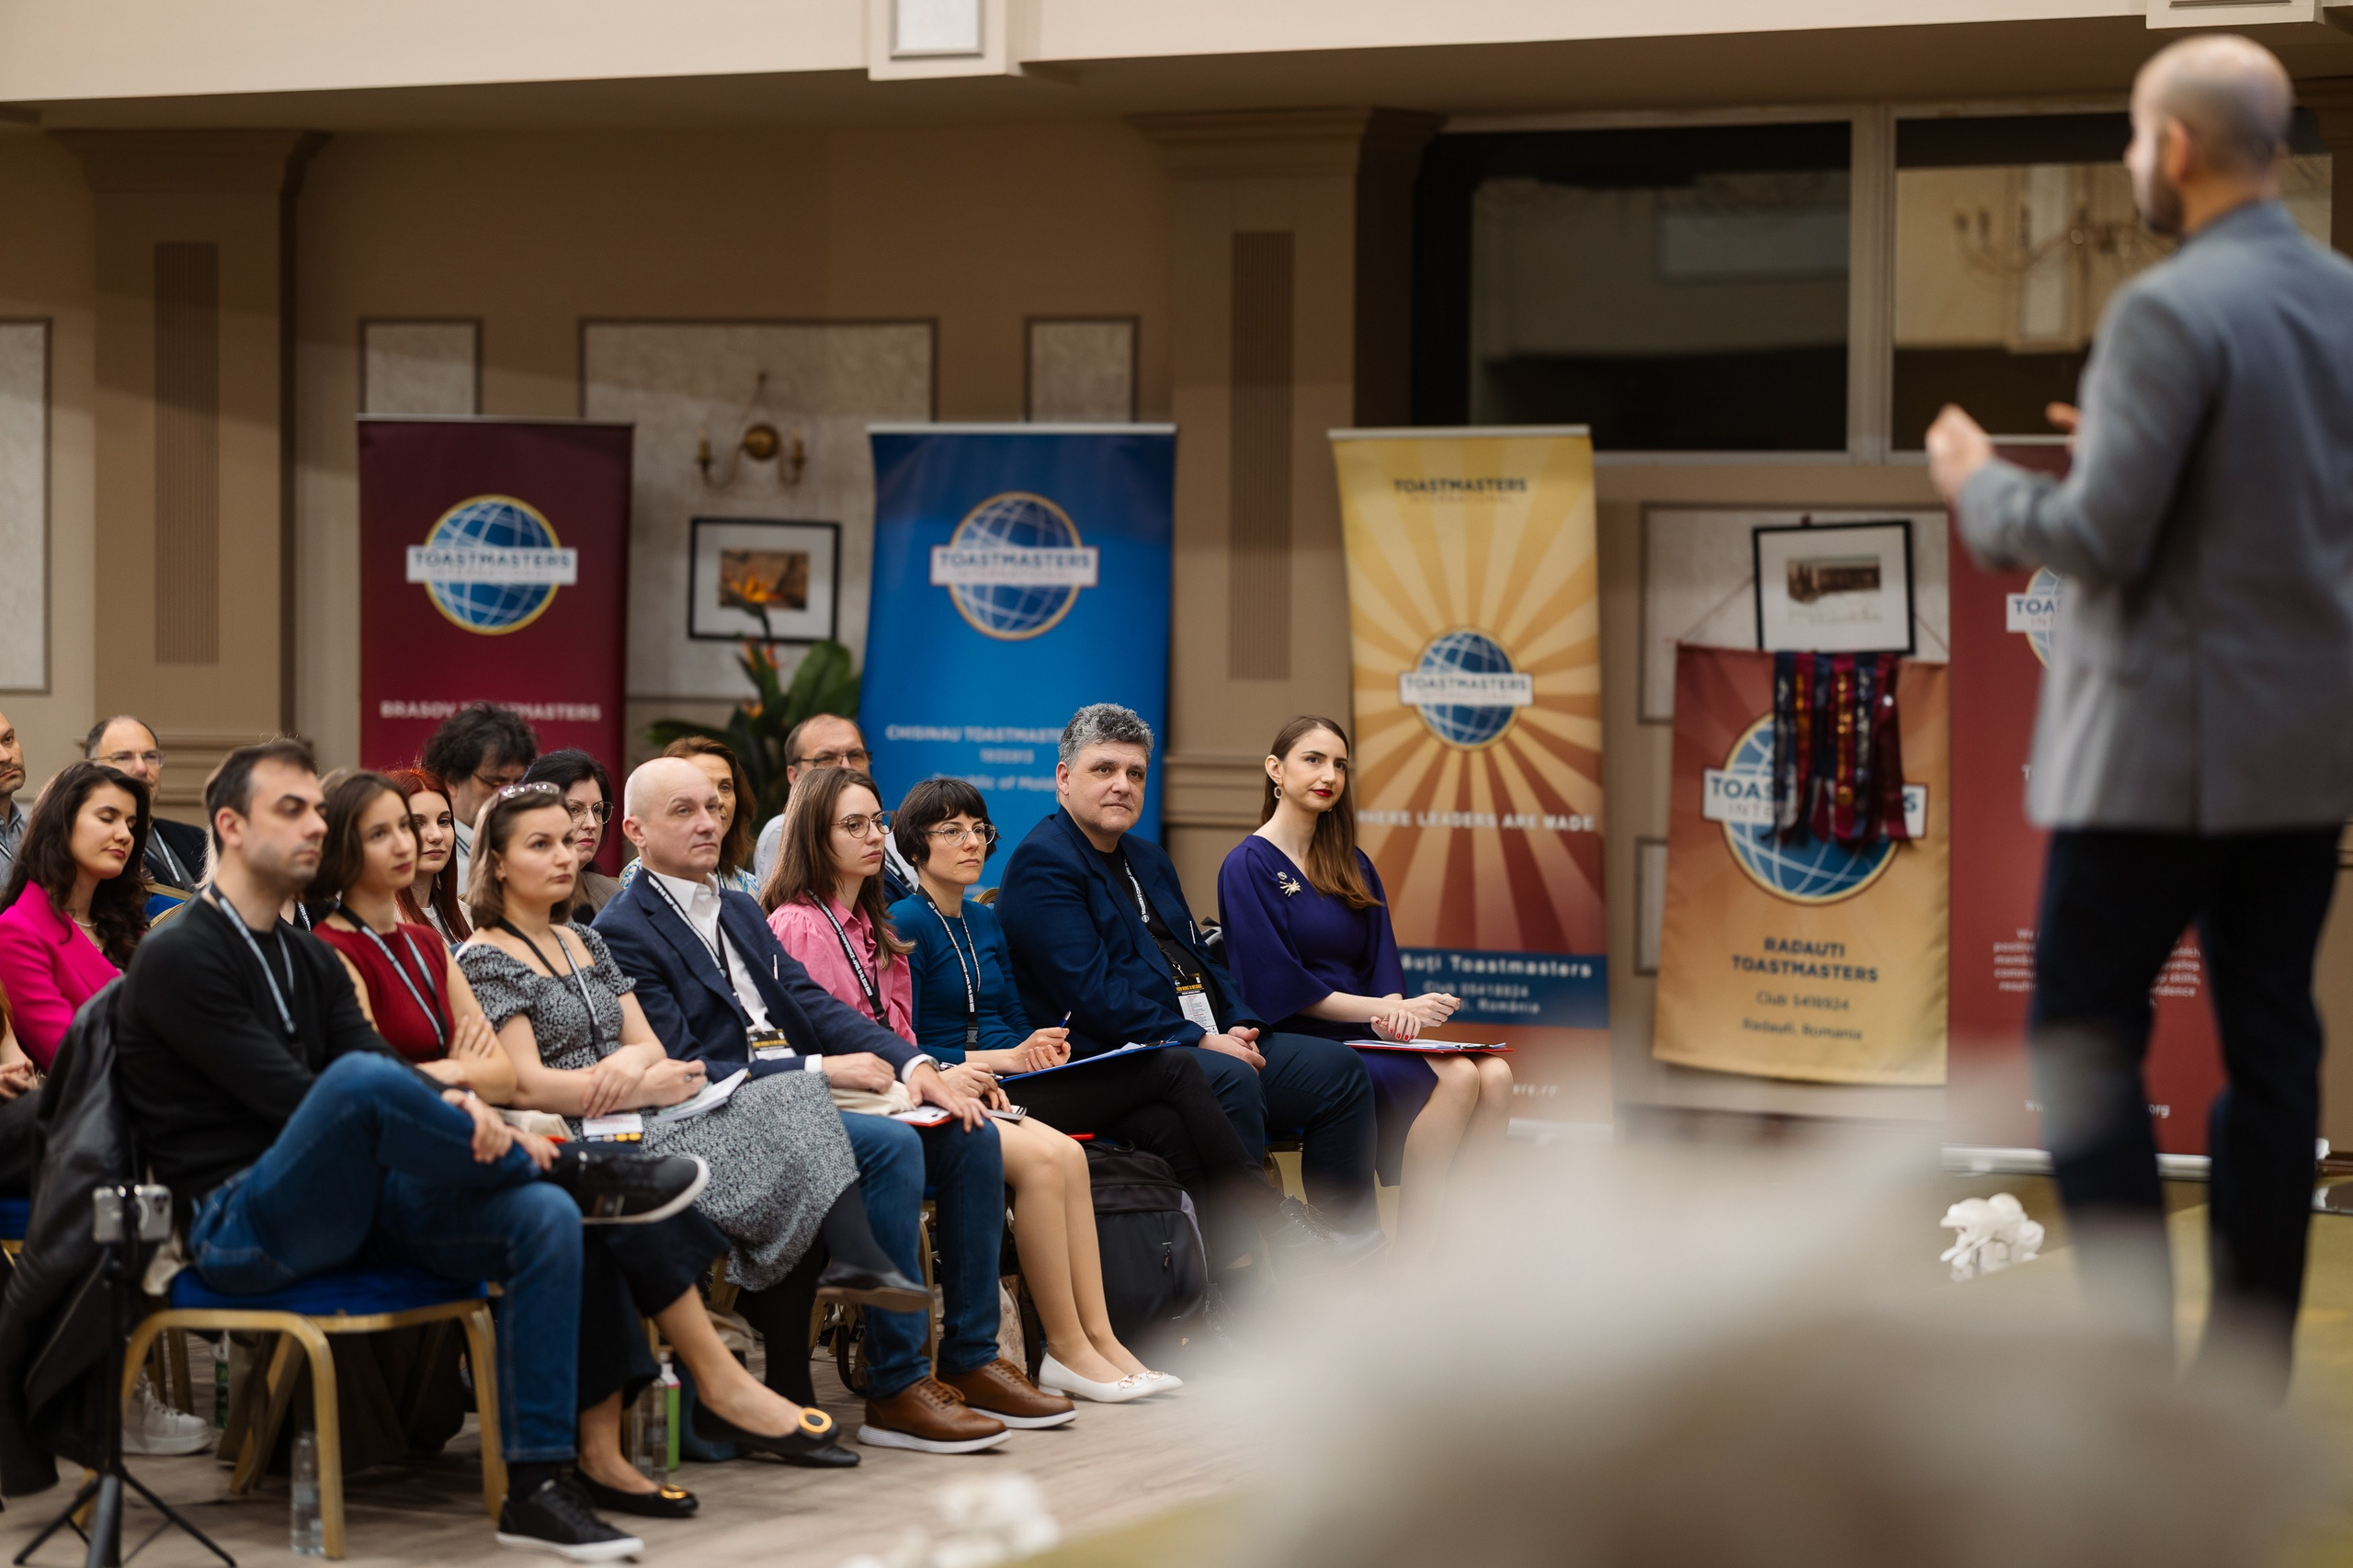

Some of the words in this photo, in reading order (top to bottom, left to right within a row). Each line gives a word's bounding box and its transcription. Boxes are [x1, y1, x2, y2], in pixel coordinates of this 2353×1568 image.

[1394, 478, 1528, 494] TOASTMASTERS
[413, 551, 571, 569] TOASTMASTERS
[939, 551, 1090, 568] TOASTMASTERS
[1405, 676, 1528, 691] TOASTMASTERS
[380, 701, 455, 719] BRASOV
[1417, 812, 1497, 829] LEADERS
[1503, 812, 1539, 830] ARE
[1542, 814, 1595, 832] MADE
[1764, 937, 1846, 958] RADAUTI
[1449, 954, 1592, 978] Toastmasters
[1732, 955, 1879, 983] TOASTMASTERS
[1756, 991, 1788, 1006] Club
